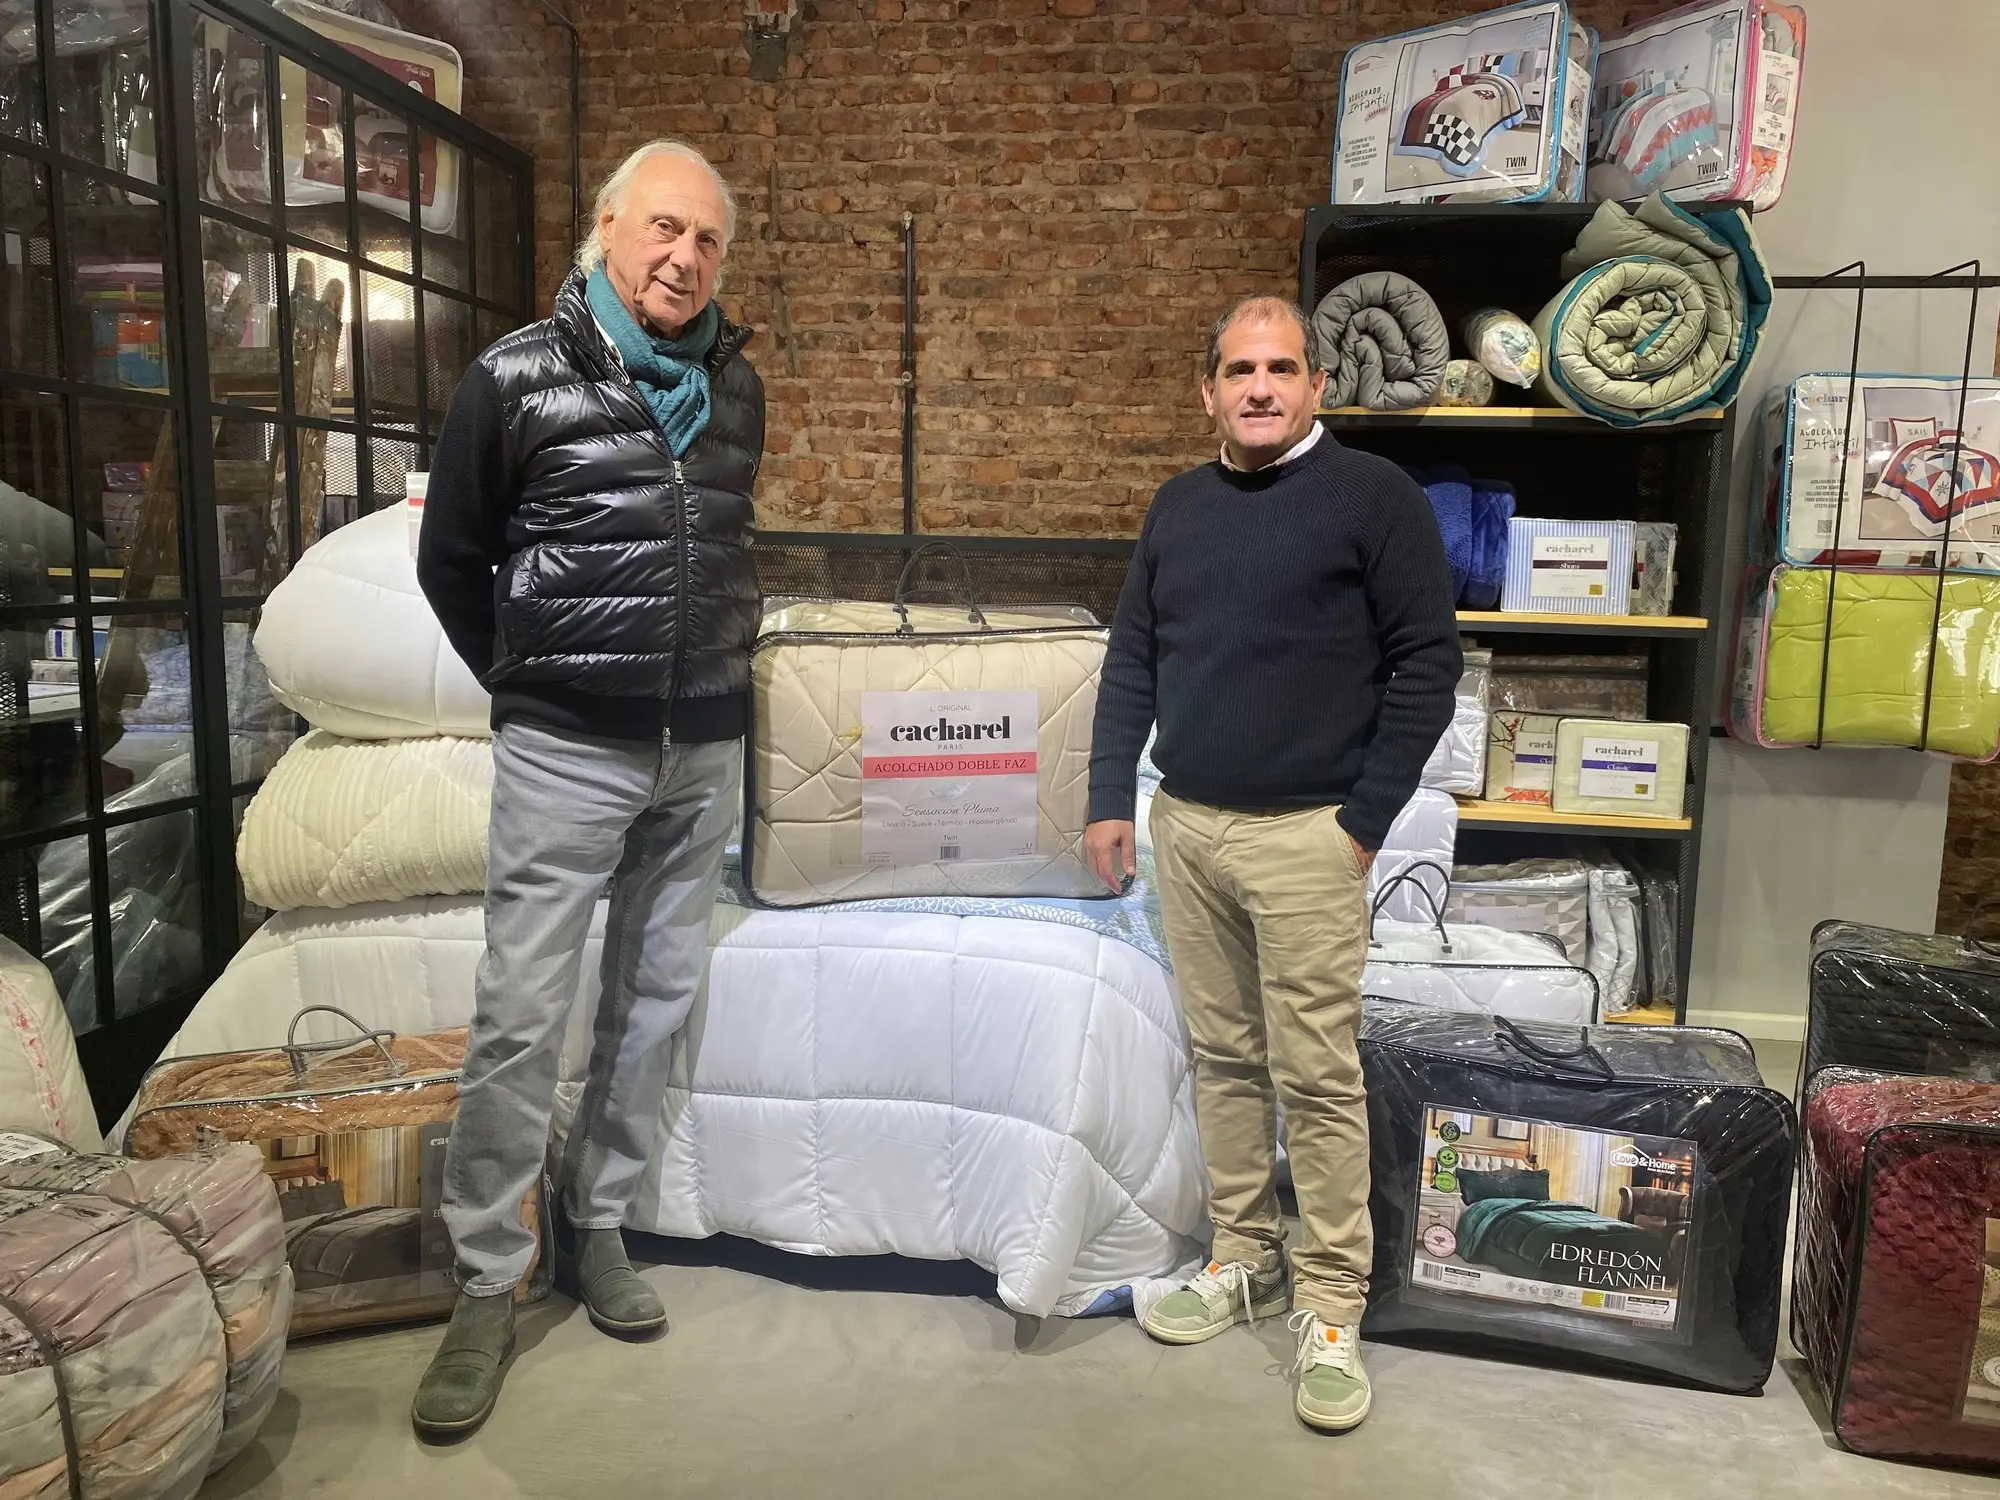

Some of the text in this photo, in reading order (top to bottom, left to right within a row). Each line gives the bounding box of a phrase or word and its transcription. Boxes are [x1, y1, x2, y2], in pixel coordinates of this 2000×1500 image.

[1505, 156, 1527, 168] TWIN
[1697, 161, 1718, 175] TWIN
[1907, 428, 1928, 436] SAIL
[1802, 436, 1859, 450] Infanil
[1546, 544, 1594, 554] cacharel
[938, 704, 971, 712] ORIGINAL
[890, 715, 1010, 741] cacharel
[1595, 745, 1643, 756] cacharel
[874, 758, 1027, 773] ACOLCHADO DOBLE FAZ
[902, 802, 1000, 817] Sensación Pluma
[912, 820, 932, 828] Suave
[1614, 1154, 1636, 1165] Love
[1648, 1158, 1676, 1171] Home
[1550, 1242, 1662, 1272] EDREDÓN
[1578, 1266, 1672, 1292] FLANNEL
